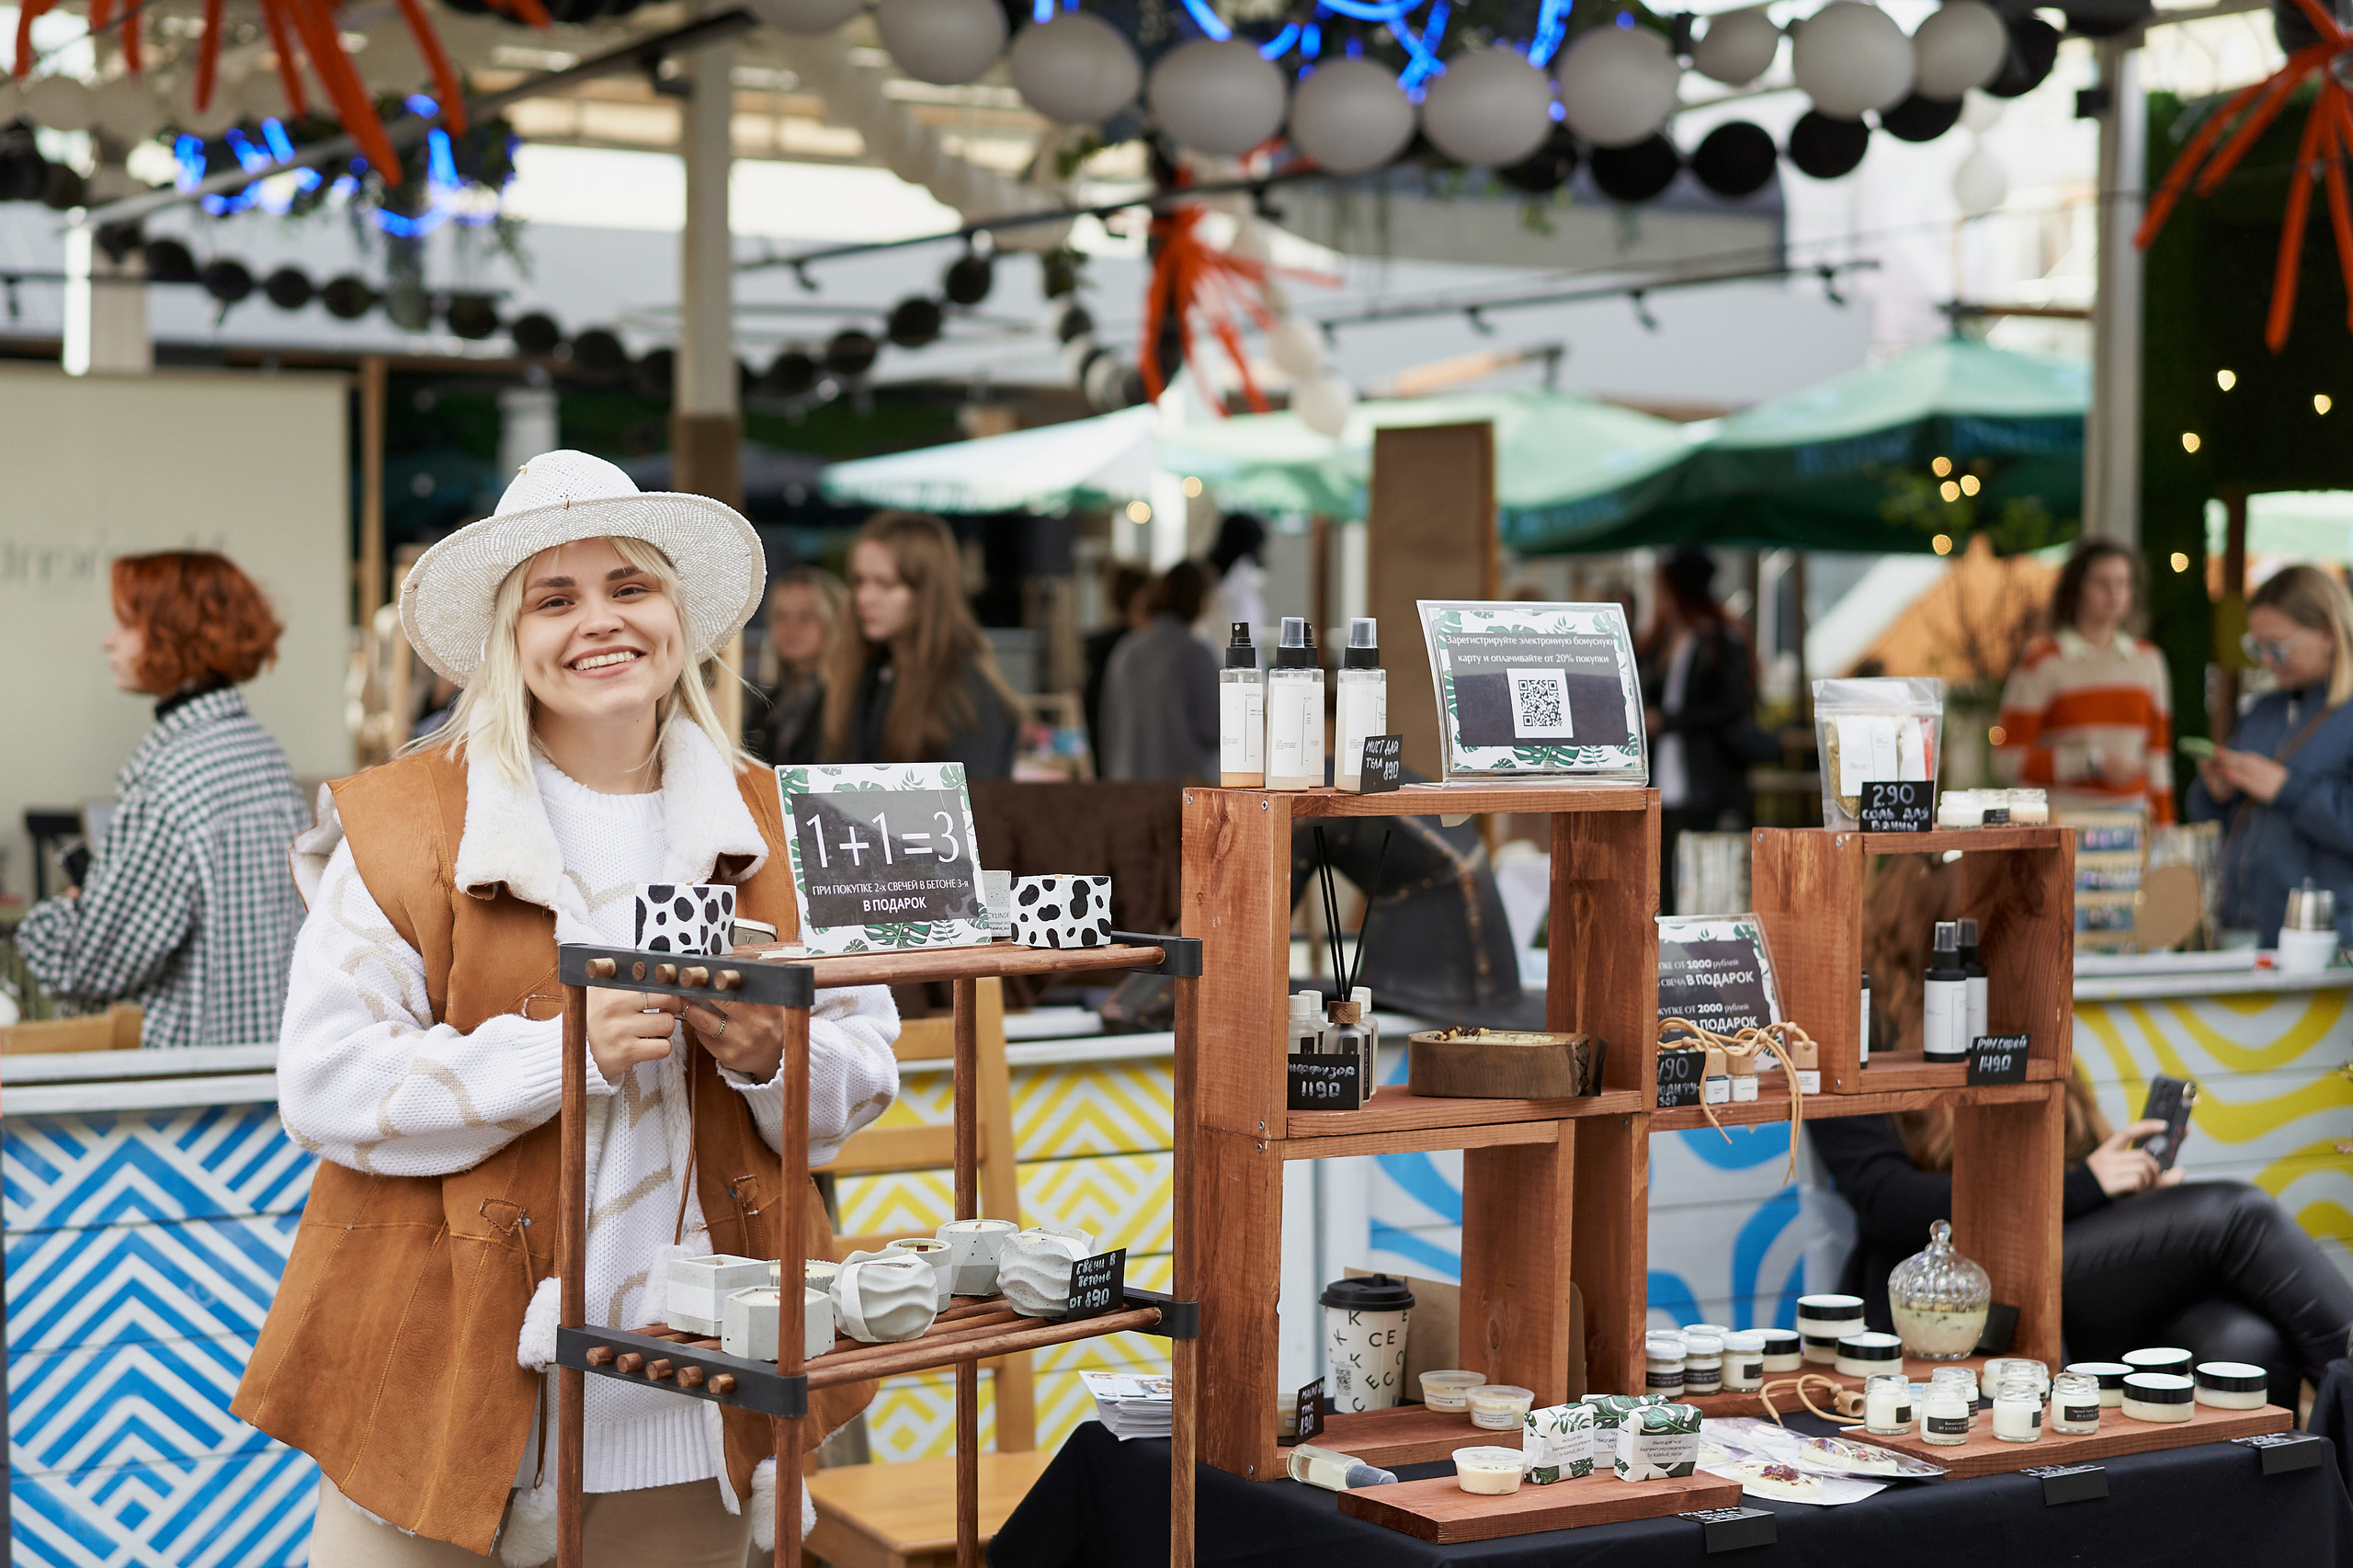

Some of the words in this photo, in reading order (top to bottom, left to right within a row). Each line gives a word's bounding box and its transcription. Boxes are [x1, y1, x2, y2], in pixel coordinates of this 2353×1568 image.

[1445, 634, 1518, 646] Зарегистрируйте
[1518, 636, 1572, 648] электронную
[1573, 636, 1614, 648] бонусную
[1458, 654, 1482, 665] карту
[1483, 654, 1489, 663] и
[1491, 653, 1543, 664] оплачивайте
[1555, 653, 1574, 663] 20%
[1575, 654, 1609, 665] покупки
[813, 885, 832, 896] ПРИ
[833, 882, 872, 895] ПОКУПКЕ
[887, 879, 918, 892] СВЕЧЕЙ
[919, 880, 926, 890] В
[926, 879, 956, 890] БЕТОНЕ
[863, 900, 871, 912] В
[872, 897, 927, 914] ПОДАРОК
[1686, 959, 1712, 970] 1000
[1713, 959, 1739, 970] рублей
[1660, 978, 1687, 987] СВЕЧА
[1686, 974, 1695, 986] В
[1696, 971, 1755, 988] ПОДАРОК
[1684, 1006, 1696, 1014] ОТ
[1698, 1003, 1722, 1014] 2000
[1724, 1003, 1750, 1014] рублей
[1699, 1016, 1758, 1033] ПОДАРОК
[1289, 1062, 1356, 1080] ИФФУЗОР
